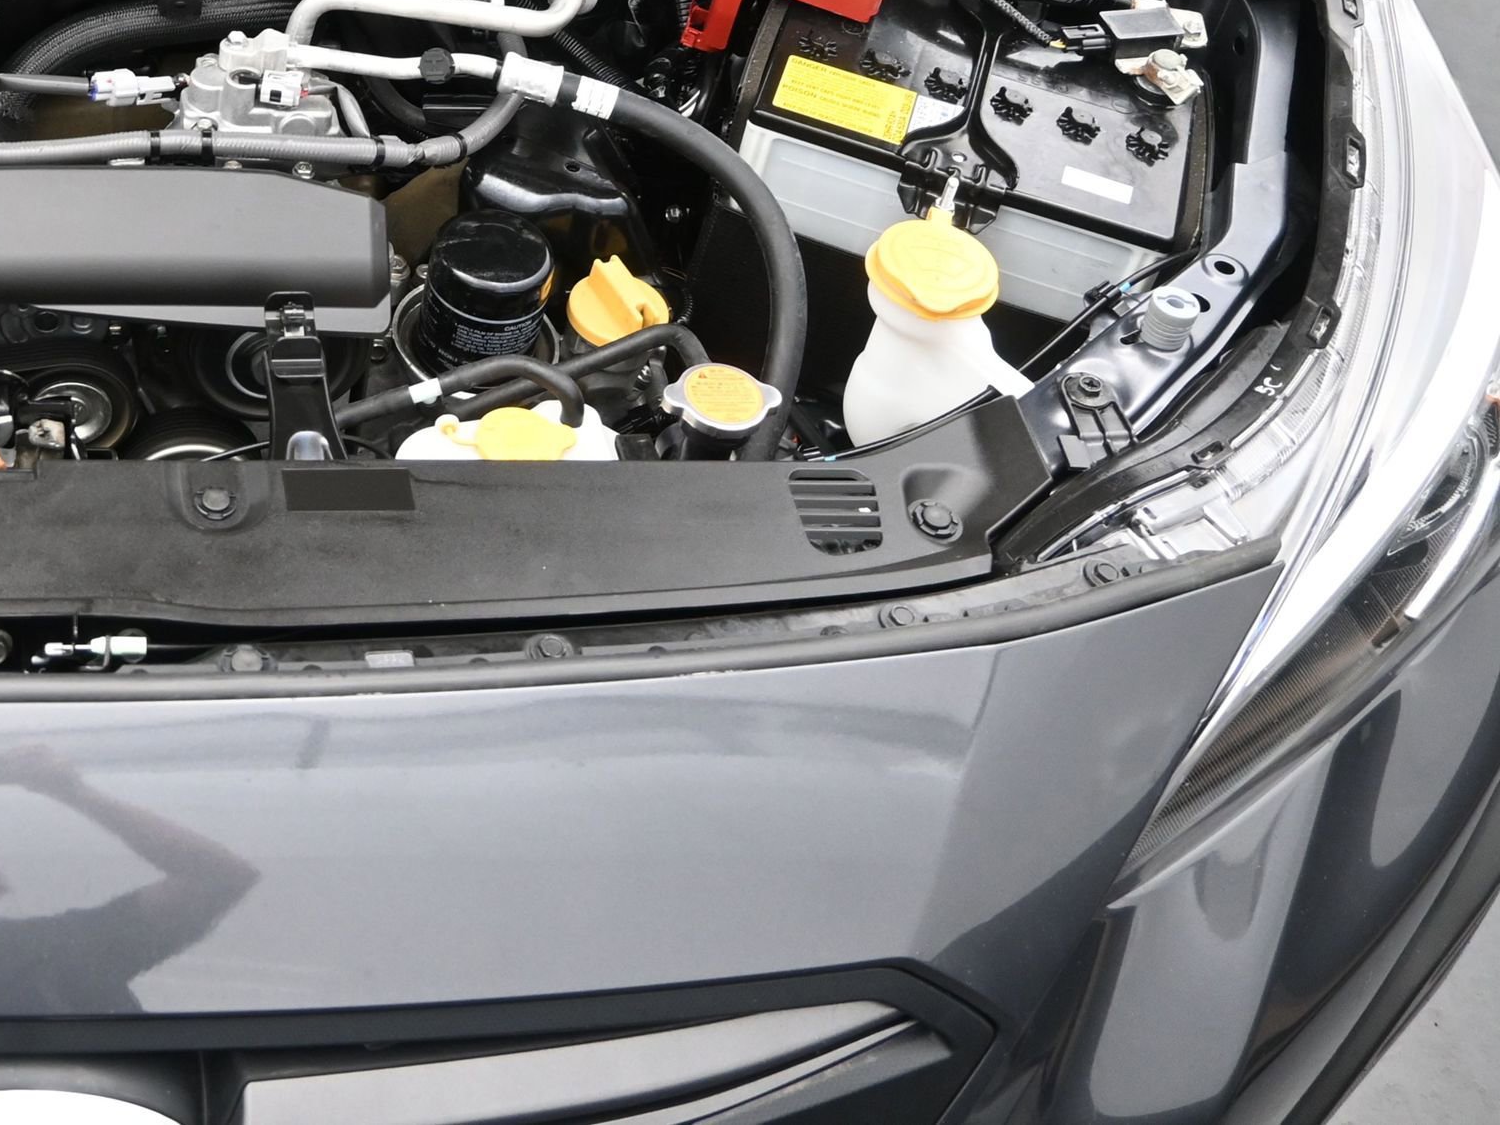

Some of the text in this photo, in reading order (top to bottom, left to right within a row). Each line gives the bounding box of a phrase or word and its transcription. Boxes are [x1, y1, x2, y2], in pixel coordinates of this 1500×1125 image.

[791, 58, 827, 73] DANGER
[781, 83, 817, 98] POISON
[504, 320, 532, 331] CAUTION
